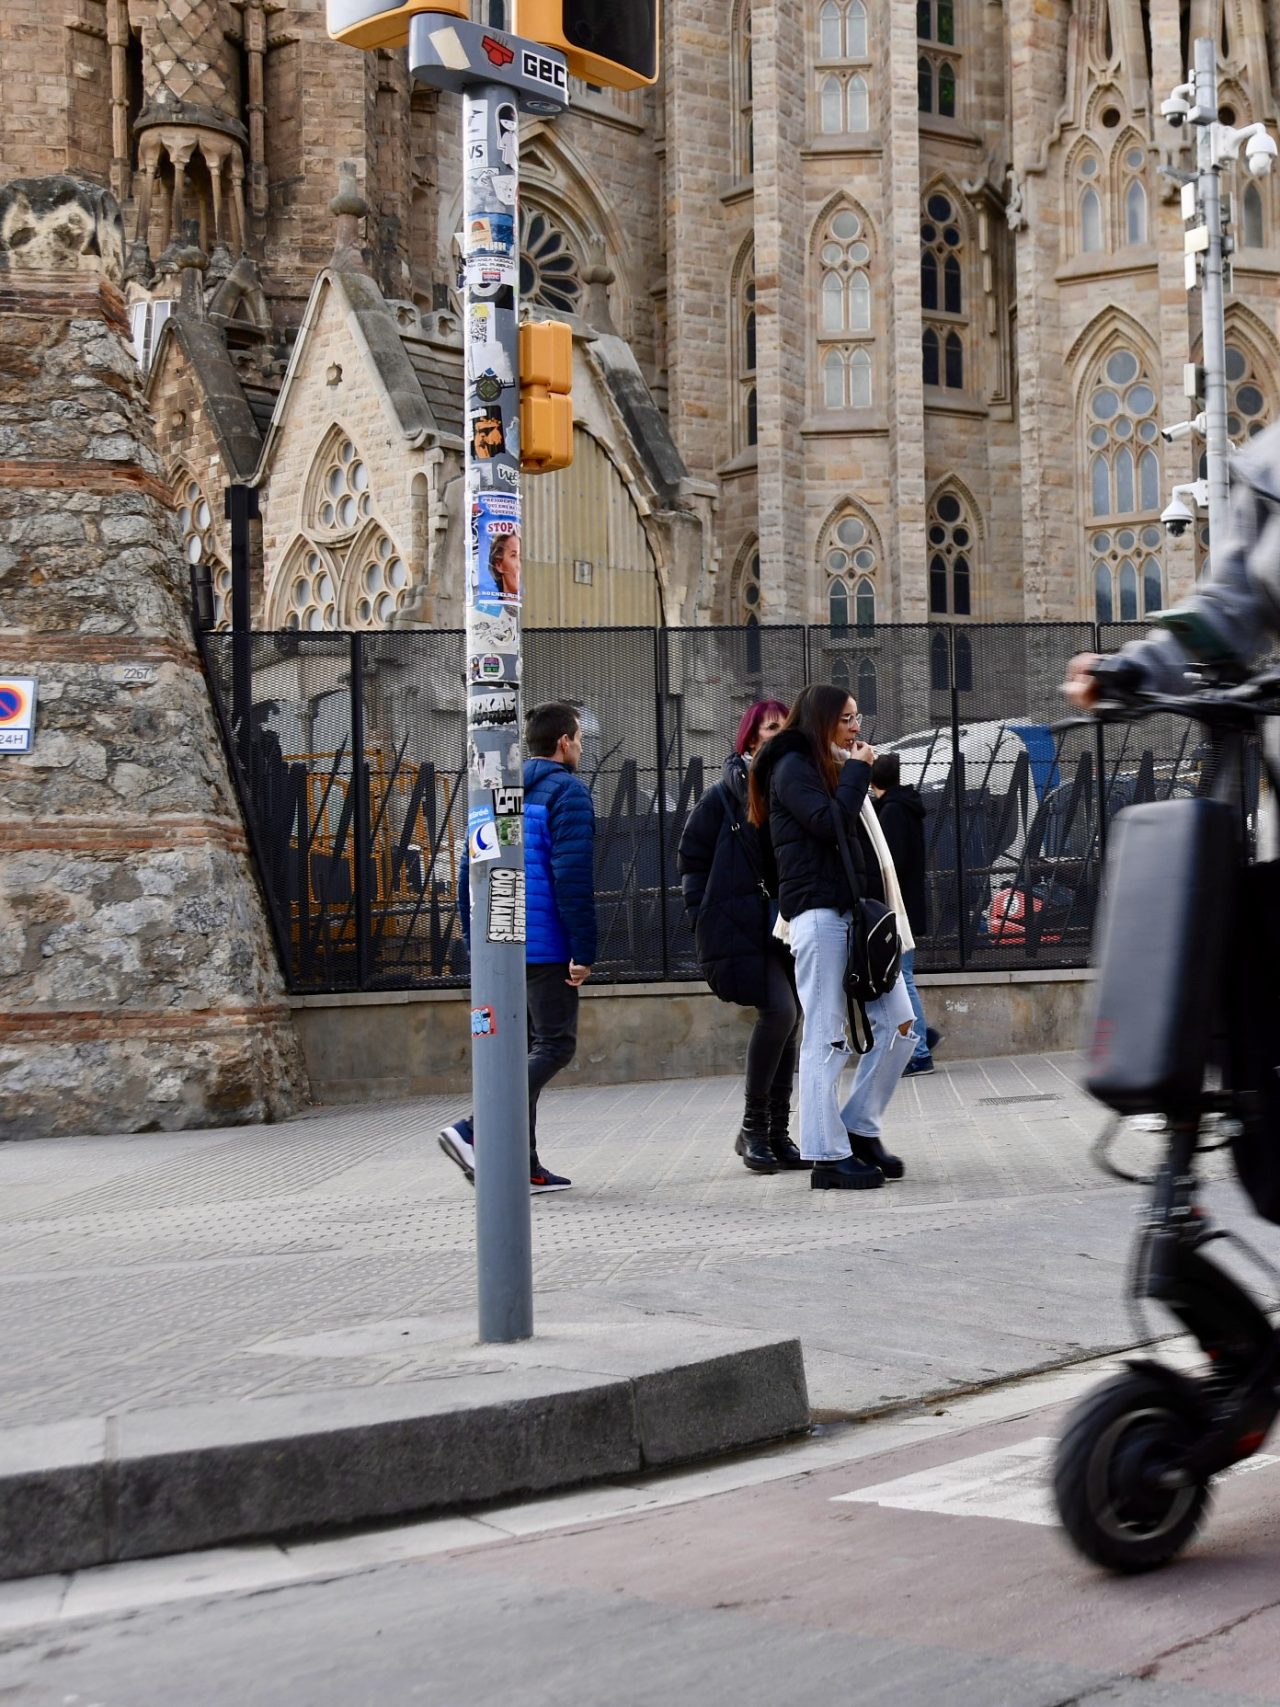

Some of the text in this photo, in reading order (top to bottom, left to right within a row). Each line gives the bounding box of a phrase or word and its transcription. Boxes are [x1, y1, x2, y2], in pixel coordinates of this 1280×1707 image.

[488, 522, 513, 533] STOP
[488, 869, 516, 942] OUR NAMES
